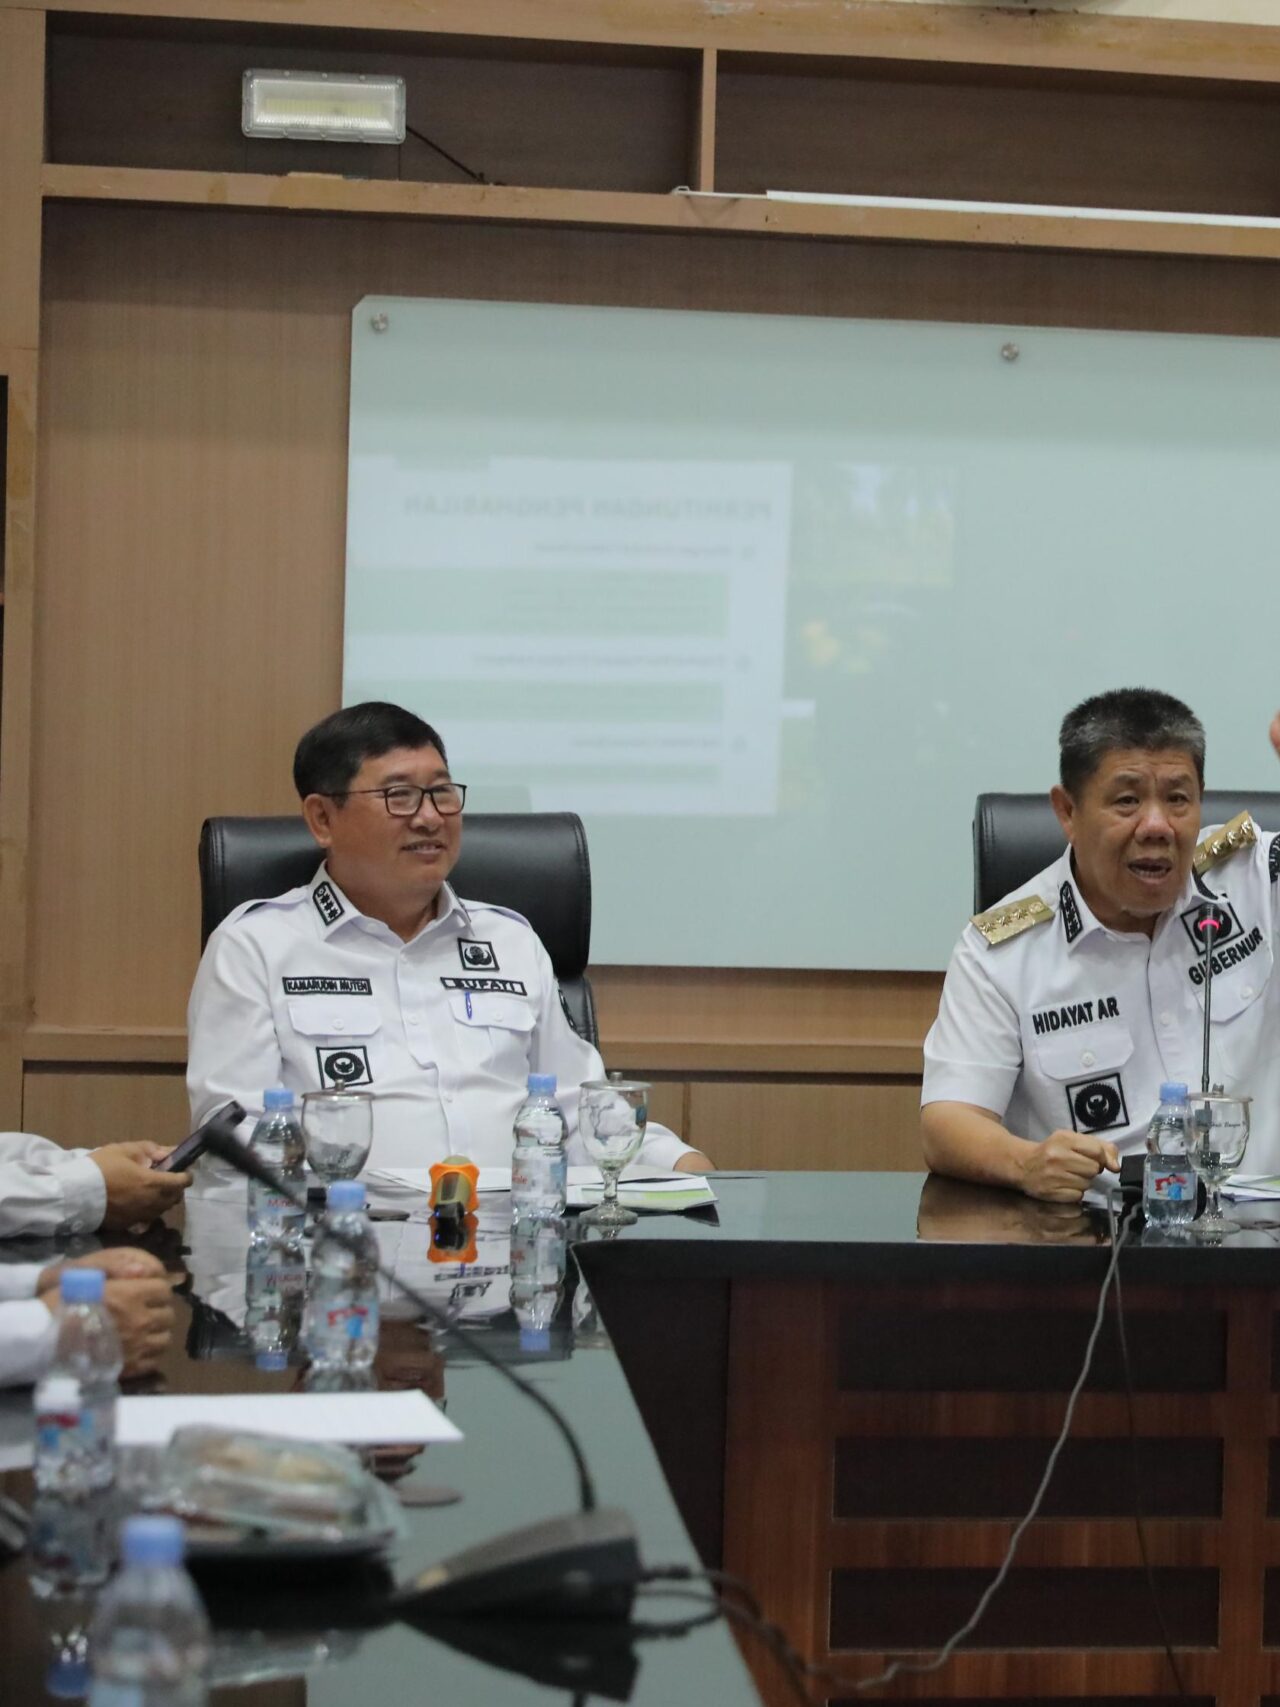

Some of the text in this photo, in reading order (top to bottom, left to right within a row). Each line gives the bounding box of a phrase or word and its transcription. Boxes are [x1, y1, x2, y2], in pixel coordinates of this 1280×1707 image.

[1188, 926, 1263, 985] GUBERNUR
[1032, 996, 1120, 1035] HIDAYAT AR
